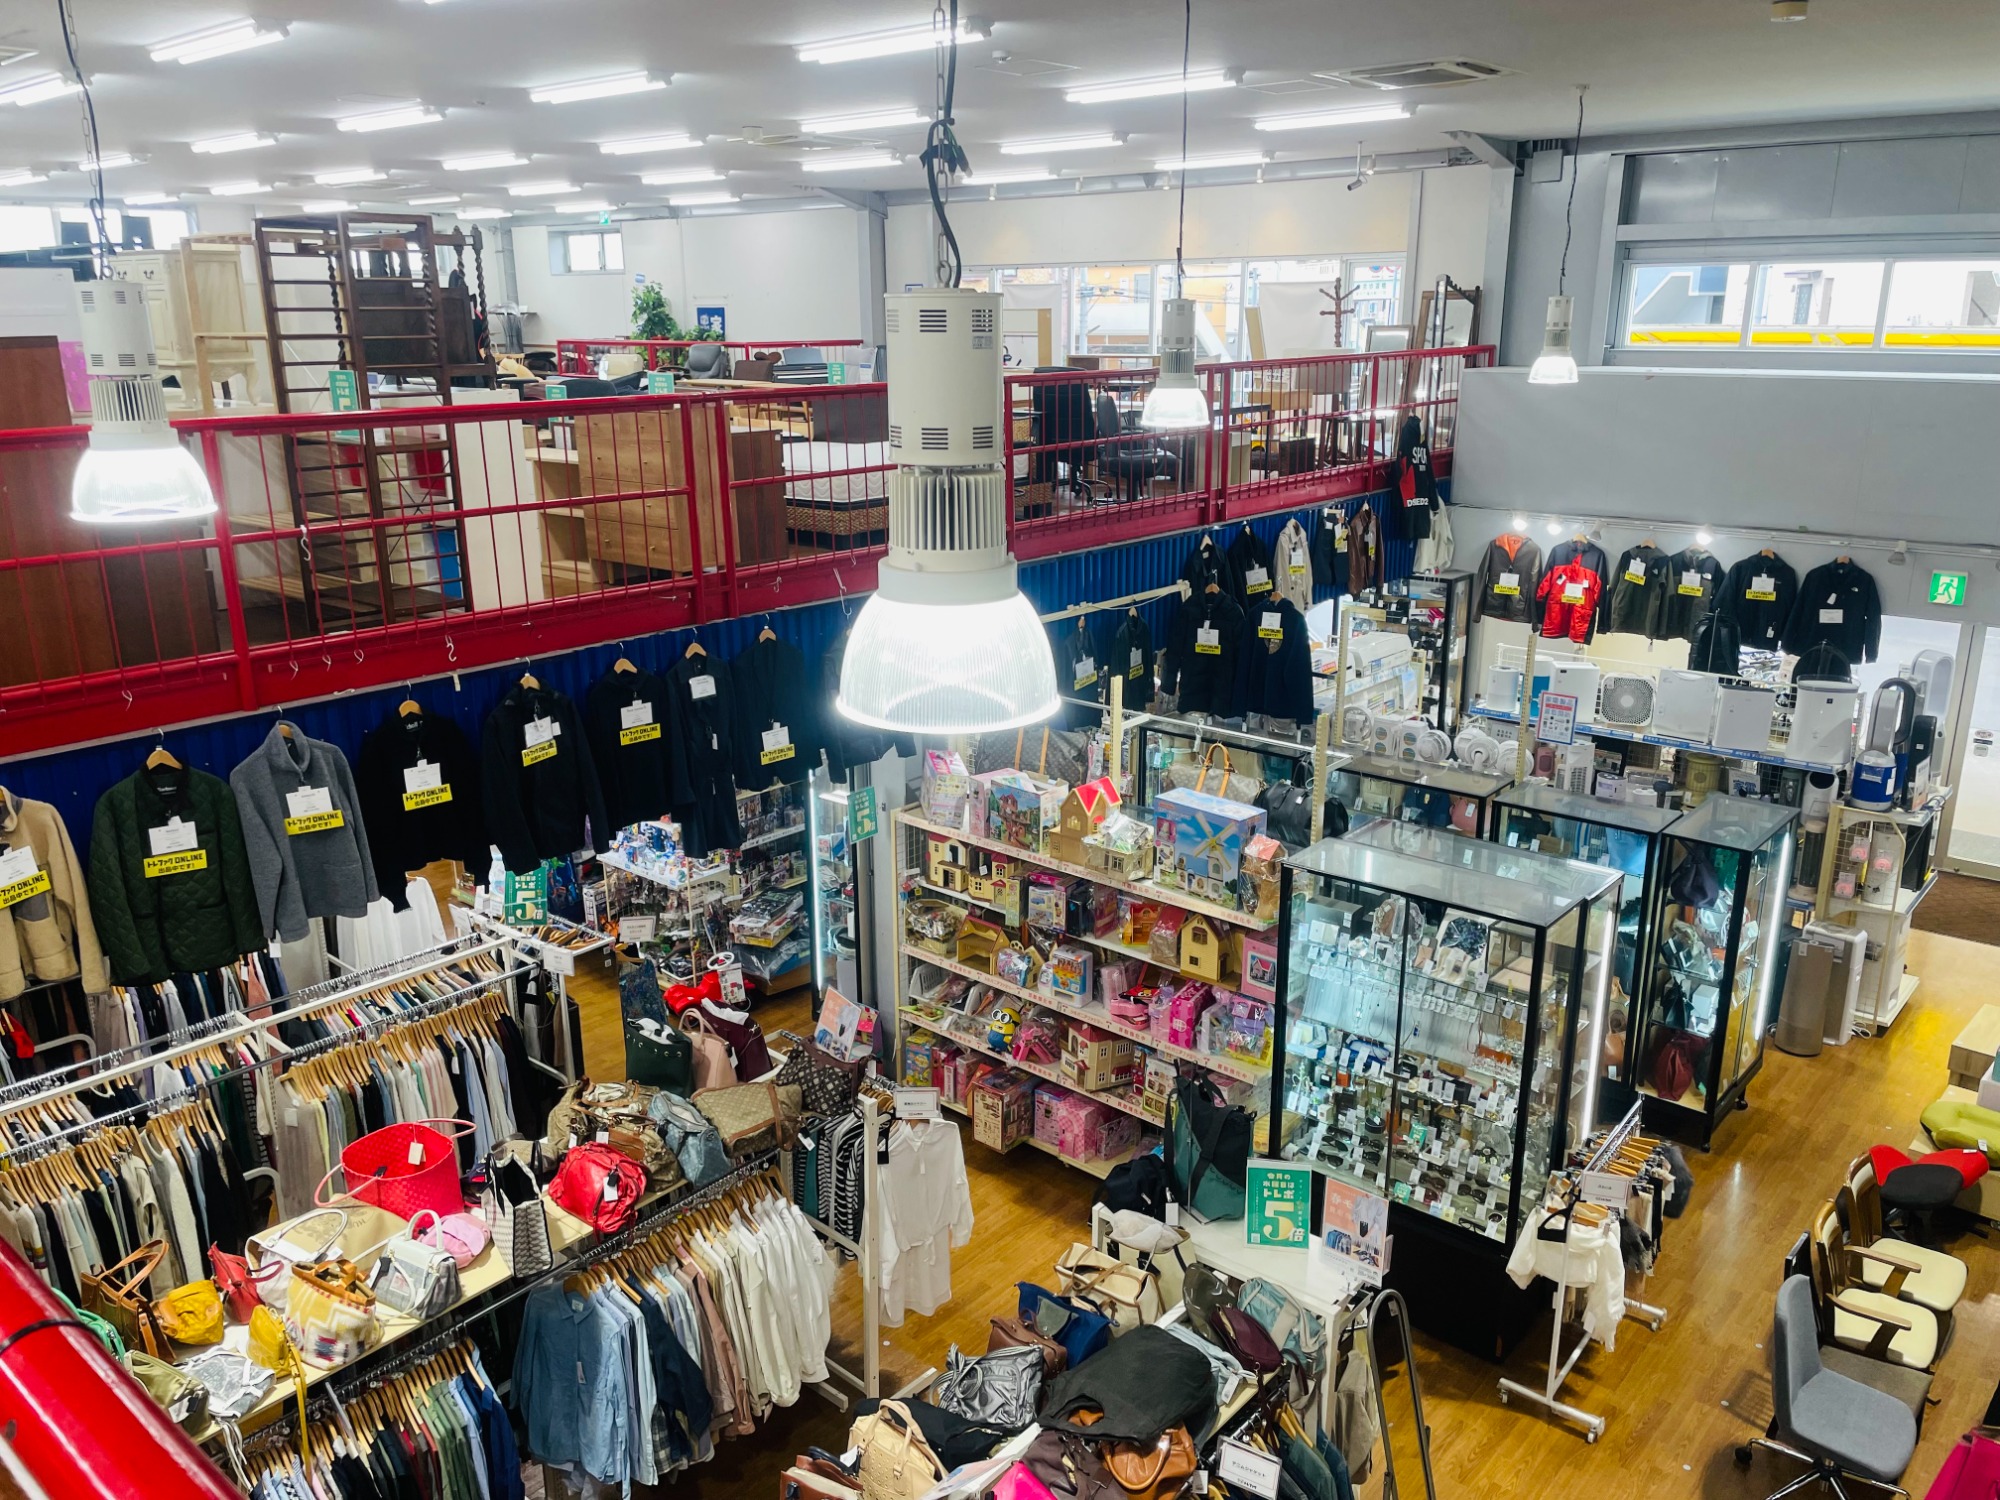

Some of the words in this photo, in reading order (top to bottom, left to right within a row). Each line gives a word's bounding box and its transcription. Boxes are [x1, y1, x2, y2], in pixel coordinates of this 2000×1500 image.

[639, 725, 659, 735] ONLINE
[426, 786, 449, 797] ONLINE
[312, 812, 340, 824] ONLINE
[174, 852, 204, 864] ONLINE
[16, 875, 46, 891] ONLINE
[1263, 1188, 1295, 1199] トレポ
